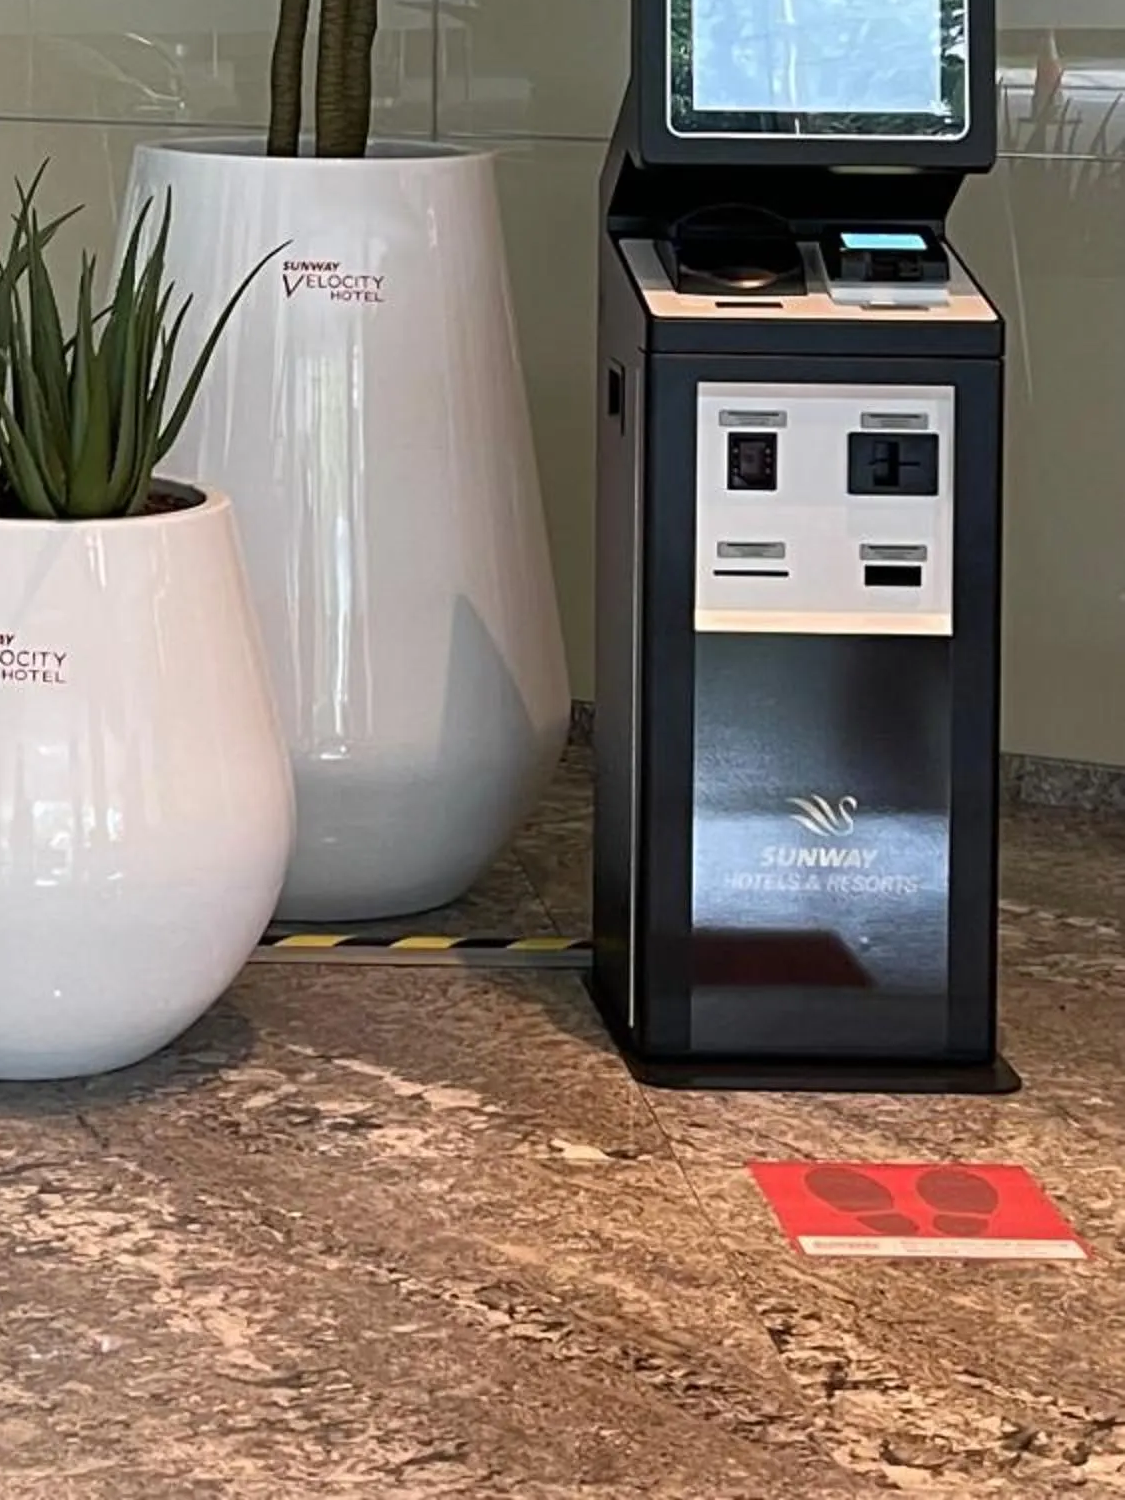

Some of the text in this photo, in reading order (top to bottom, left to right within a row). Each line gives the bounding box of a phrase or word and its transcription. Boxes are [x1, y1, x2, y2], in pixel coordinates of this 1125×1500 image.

[283, 260, 341, 272] SUNWAY
[283, 274, 385, 298] VELOCITY
[330, 290, 385, 303] HOTEL
[1, 668, 68, 684] HOTEL
[760, 847, 878, 869] SUNWAY
